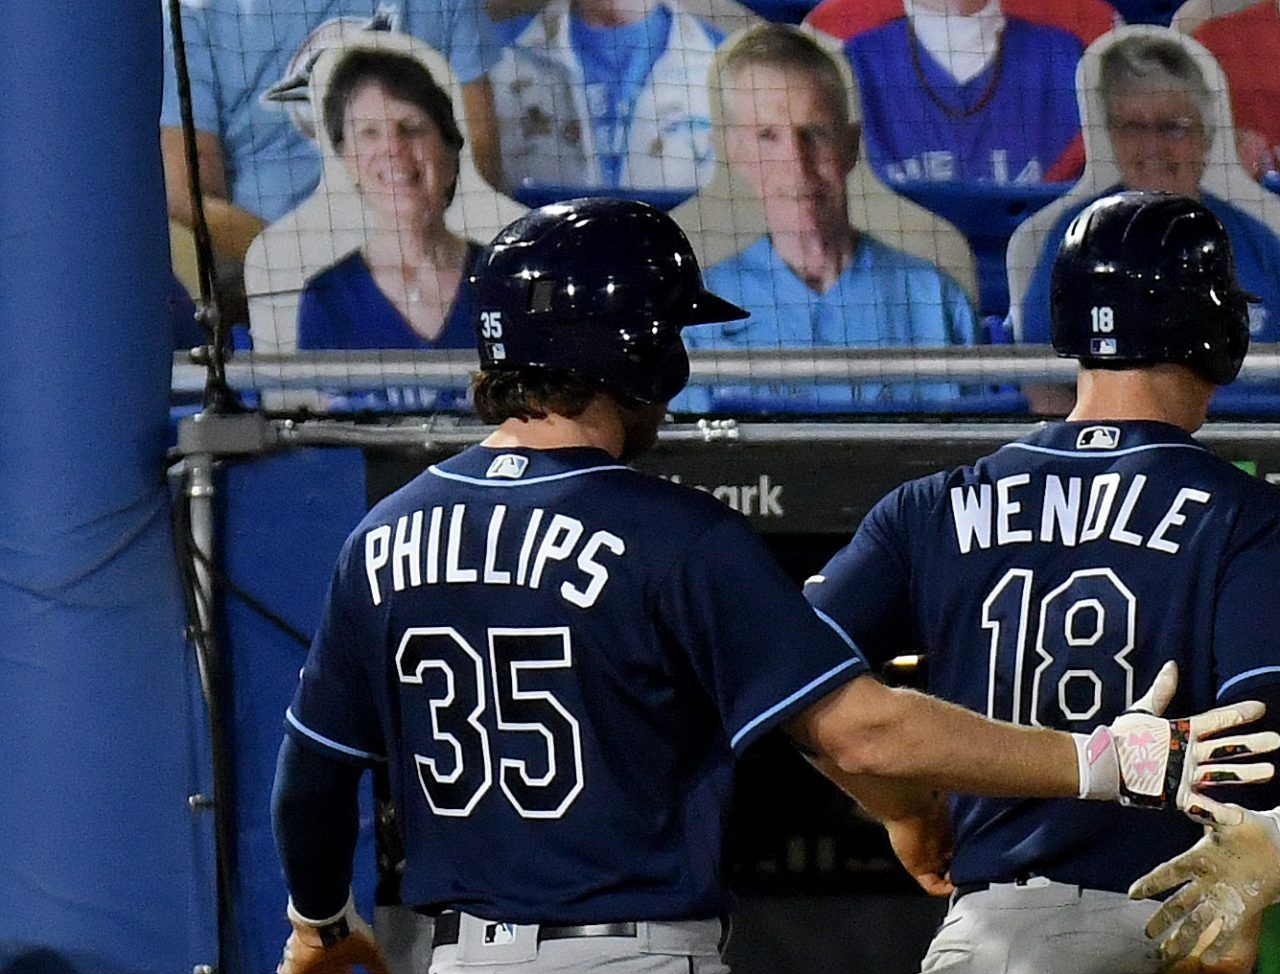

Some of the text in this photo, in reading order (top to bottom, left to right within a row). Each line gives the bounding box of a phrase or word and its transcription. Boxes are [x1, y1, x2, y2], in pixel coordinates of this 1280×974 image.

[480, 311, 503, 338] 35
[1090, 306, 1114, 333] 18
[365, 503, 626, 608] PHILLIPS
[950, 473, 1211, 554] WENDLE
[981, 567, 1137, 731] 18
[395, 626, 584, 819] 35
